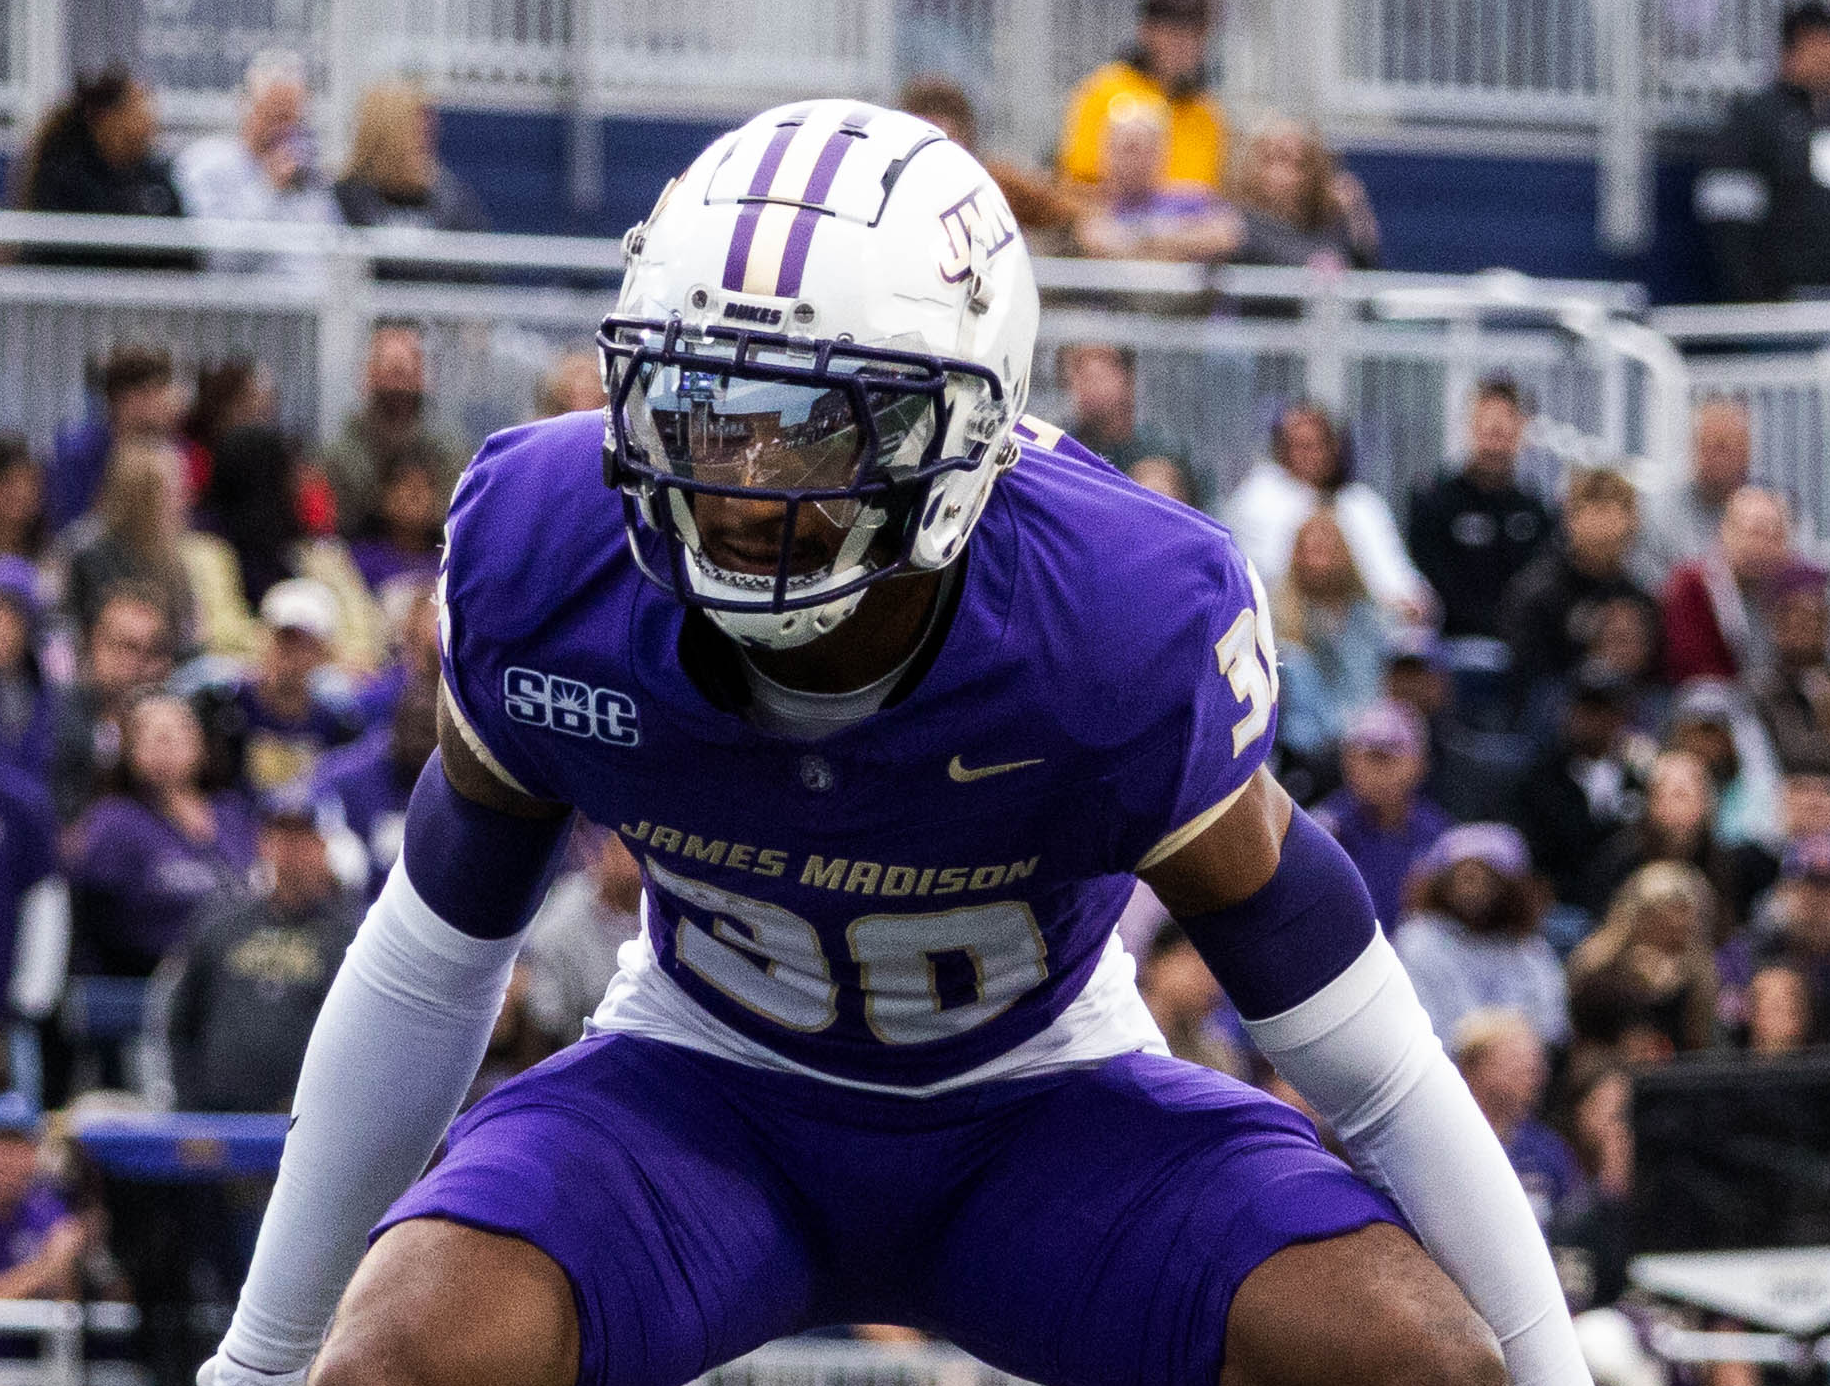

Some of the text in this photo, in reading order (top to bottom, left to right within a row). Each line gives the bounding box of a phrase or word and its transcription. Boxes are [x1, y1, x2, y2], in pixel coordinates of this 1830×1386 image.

[723, 302, 782, 326] DUKES
[504, 666, 639, 747] SBC
[620, 820, 1042, 897] JAMES MADISON
[644, 852, 1050, 1047] 30
